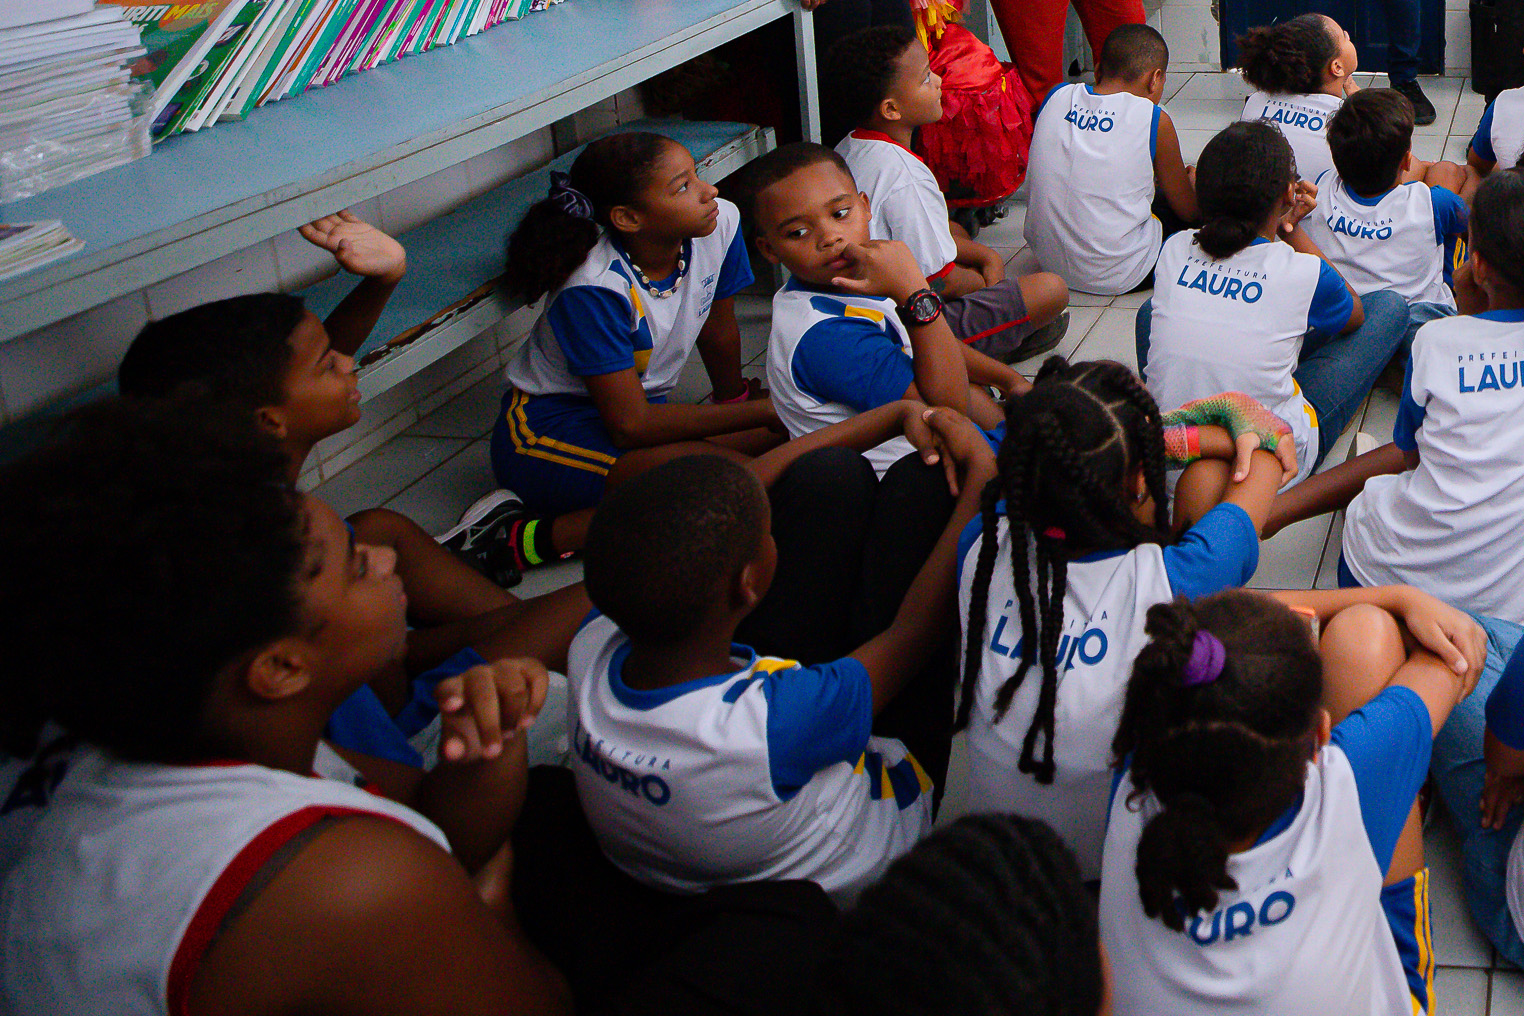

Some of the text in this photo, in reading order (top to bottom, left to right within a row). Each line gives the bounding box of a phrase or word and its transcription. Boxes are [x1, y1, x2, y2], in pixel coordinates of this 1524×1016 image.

[1260, 106, 1323, 131] LAURO
[1267, 99, 1327, 116] PREFEITURA
[1064, 109, 1114, 132] LAURO
[1187, 256, 1267, 281] PREFEITURA
[1177, 264, 1263, 304] LAURO
[1189, 890, 1296, 948] URO
